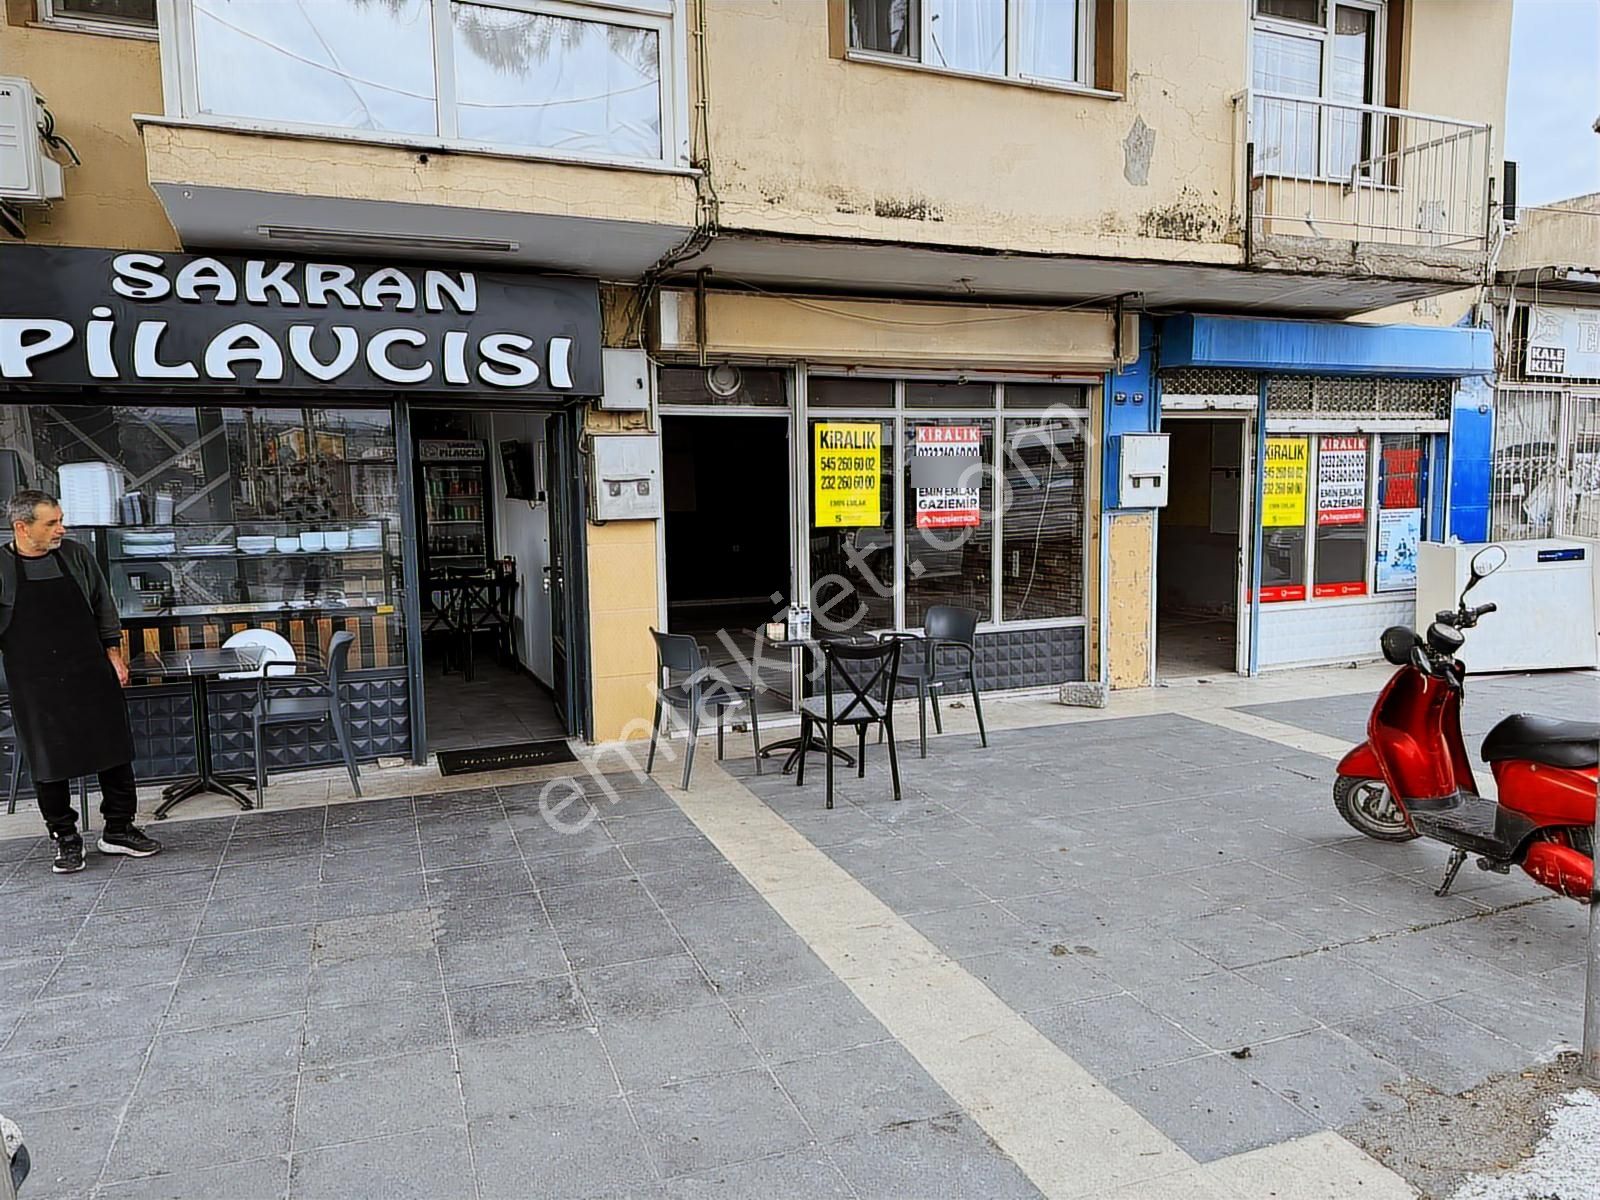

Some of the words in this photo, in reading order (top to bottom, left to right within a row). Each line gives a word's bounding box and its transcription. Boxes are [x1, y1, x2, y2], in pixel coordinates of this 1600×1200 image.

[0, 306, 573, 389] PİLAVCISI
[1532, 348, 1564, 360] KALE
[821, 456, 836, 471] 545
[838, 456, 852, 471] 260
[854, 457, 864, 471] 60
[865, 457, 875, 471] 02
[821, 475, 836, 490] 232
[838, 475, 852, 490] 260
[854, 475, 863, 490] 60
[865, 475, 875, 489] 00
